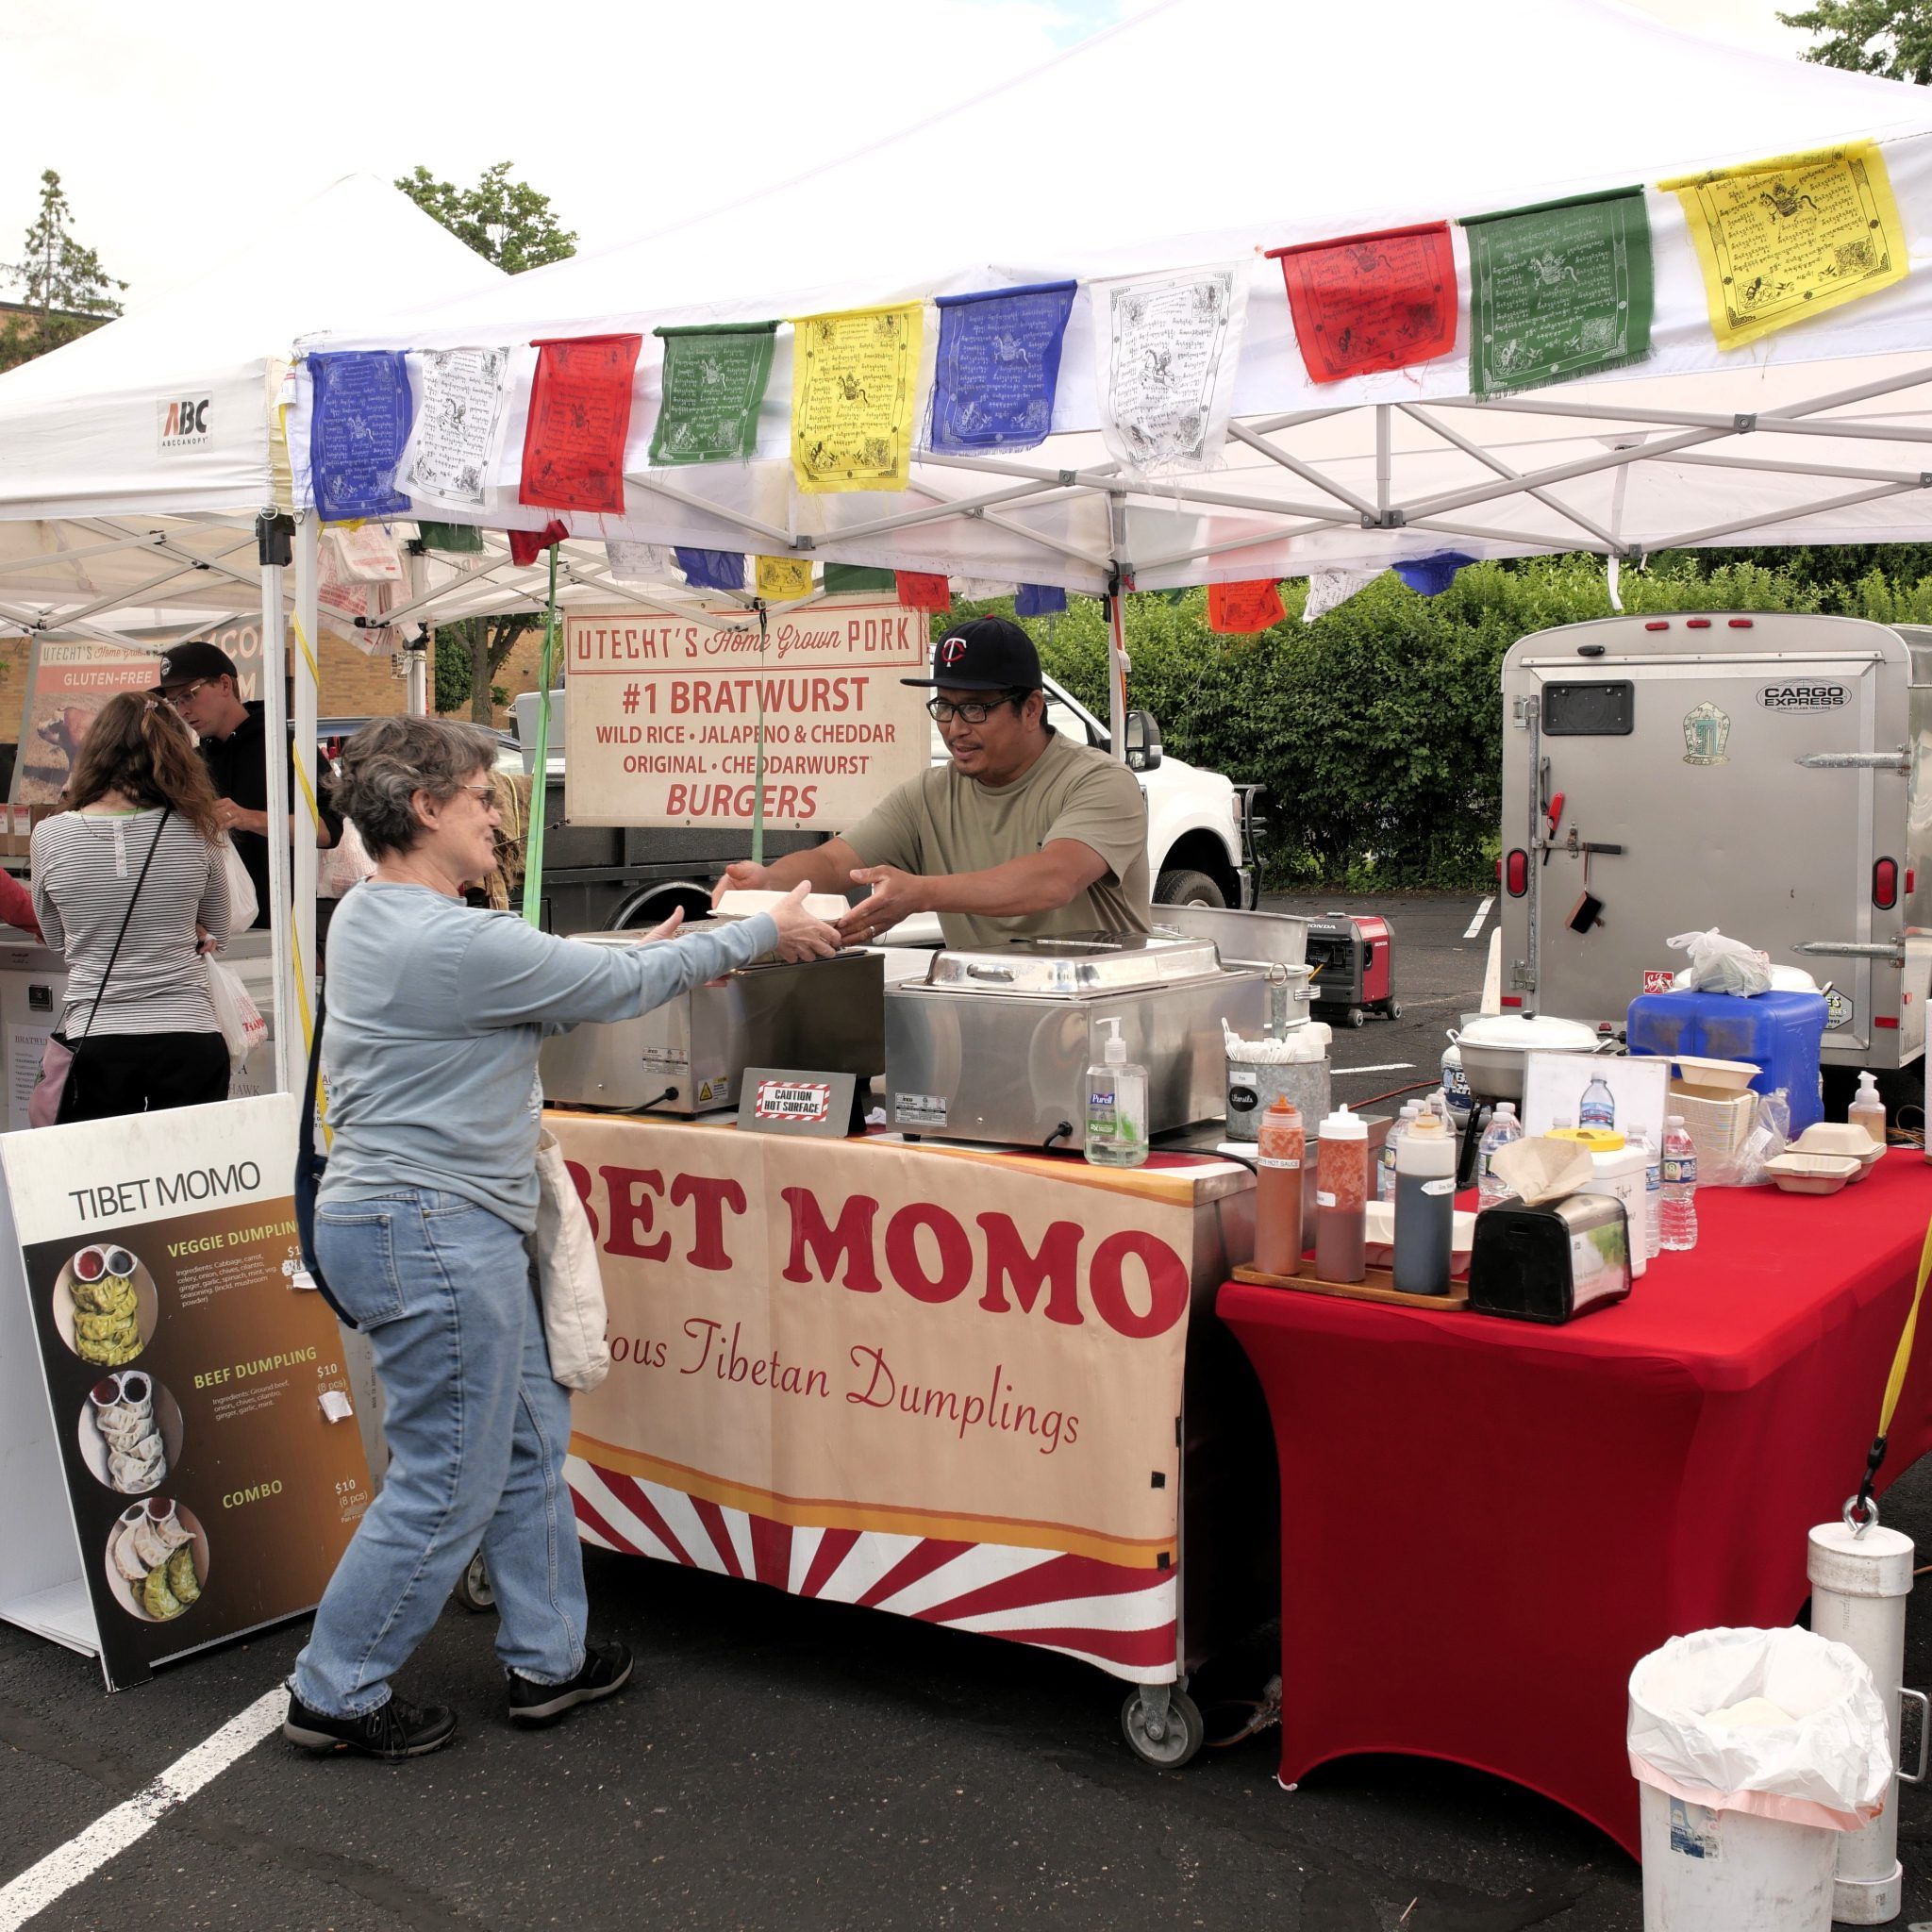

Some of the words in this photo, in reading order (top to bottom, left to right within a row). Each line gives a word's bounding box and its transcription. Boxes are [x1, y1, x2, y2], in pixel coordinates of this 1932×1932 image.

[163, 399, 209, 437] ABC
[578, 627, 698, 659] UTECHT'S
[705, 630, 771, 655] Home
[777, 624, 841, 659] Grown
[848, 617, 910, 653] PORK
[43, 645, 92, 660] UTECHT'S
[63, 671, 154, 687] GLUTEN-FREE
[622, 682, 657, 714] #1
[670, 677, 870, 714] BRATWURST
[1764, 686, 1843, 697] CARGO
[1764, 697, 1844, 706] EXPRESS
[596, 725, 642, 743] WILD
[646, 725, 685, 743] RICE
[699, 724, 791, 743] JALAPENO
[793, 724, 808, 743] &
[811, 724, 895, 743] CHEDDAR
[623, 755, 707, 774] ORIGINAL
[666, 783, 818, 819] BURGERS
[774, 1090, 812, 1101] CAUTION
[1092, 1093, 1113, 1104] Purell
[764, 1101, 782, 1111] HOT
[782, 1102, 821, 1113] SURFACE
[68, 1178, 150, 1221] TIBET
[156, 1160, 260, 1206] MOMO
[167, 1234, 225, 1257] VEGGIE
[227, 1220, 298, 1246] DUMPLIN
[287, 1245, 301, 1258] $1
[780, 1186, 1191, 1340] MOMO
[234, 1275, 268, 1288] mushroom
[194, 1368, 231, 1389] BEEF
[235, 1346, 318, 1379] DUMPLING
[317, 1363, 338, 1378] $10
[604, 1318, 668, 1369] ous
[680, 1317, 831, 1399] Tibetan
[845, 1344, 1080, 1455] Dumplings
[223, 1479, 283, 1508] COMBO
[335, 1479, 356, 1495] $10
